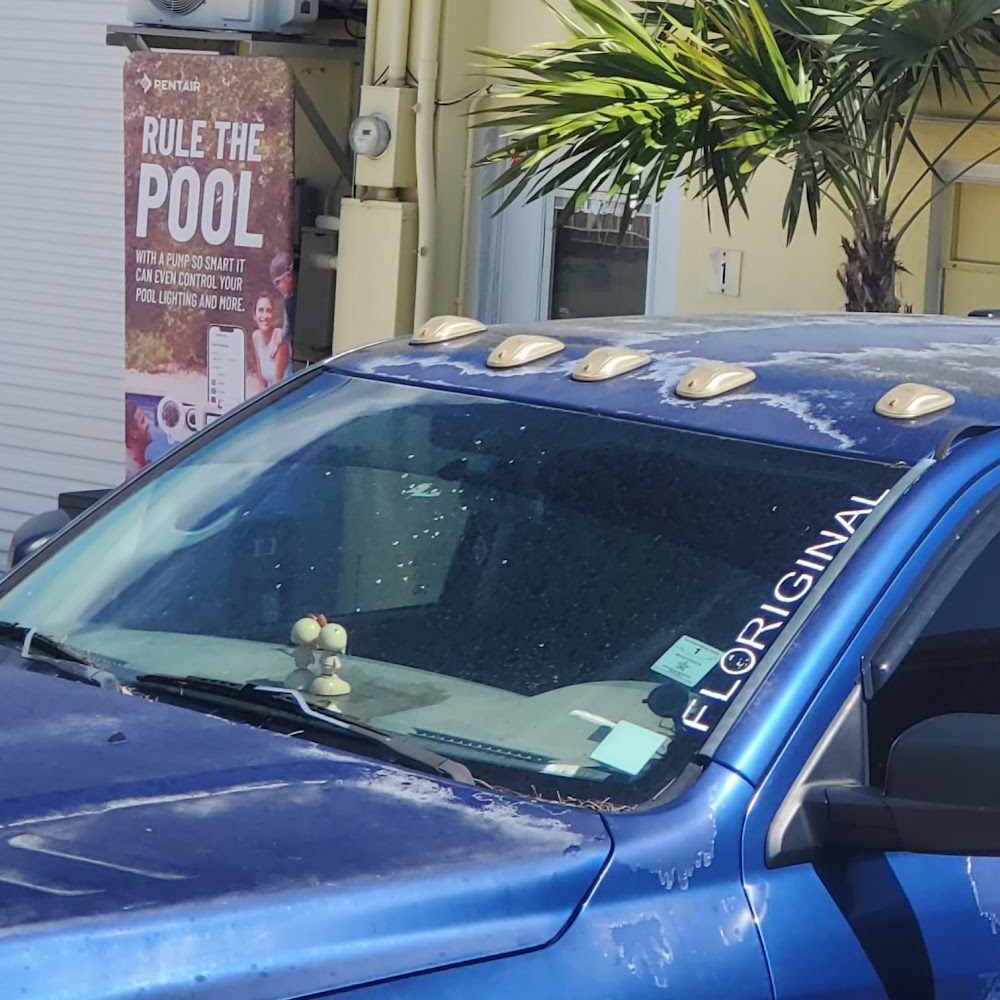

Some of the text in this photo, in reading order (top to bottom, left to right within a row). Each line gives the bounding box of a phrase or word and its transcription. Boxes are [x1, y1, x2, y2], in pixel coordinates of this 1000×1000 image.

[154, 79, 201, 92] PENTAIR
[142, 116, 265, 162] RULE THE
[135, 162, 264, 248] POOL
[135, 249, 246, 273] WITH A PUMP SO SMART IT
[135, 267, 243, 291] CAN EVEN CONTROL YOUR
[135, 287, 245, 312] POOL LIGHTING AND MORE.
